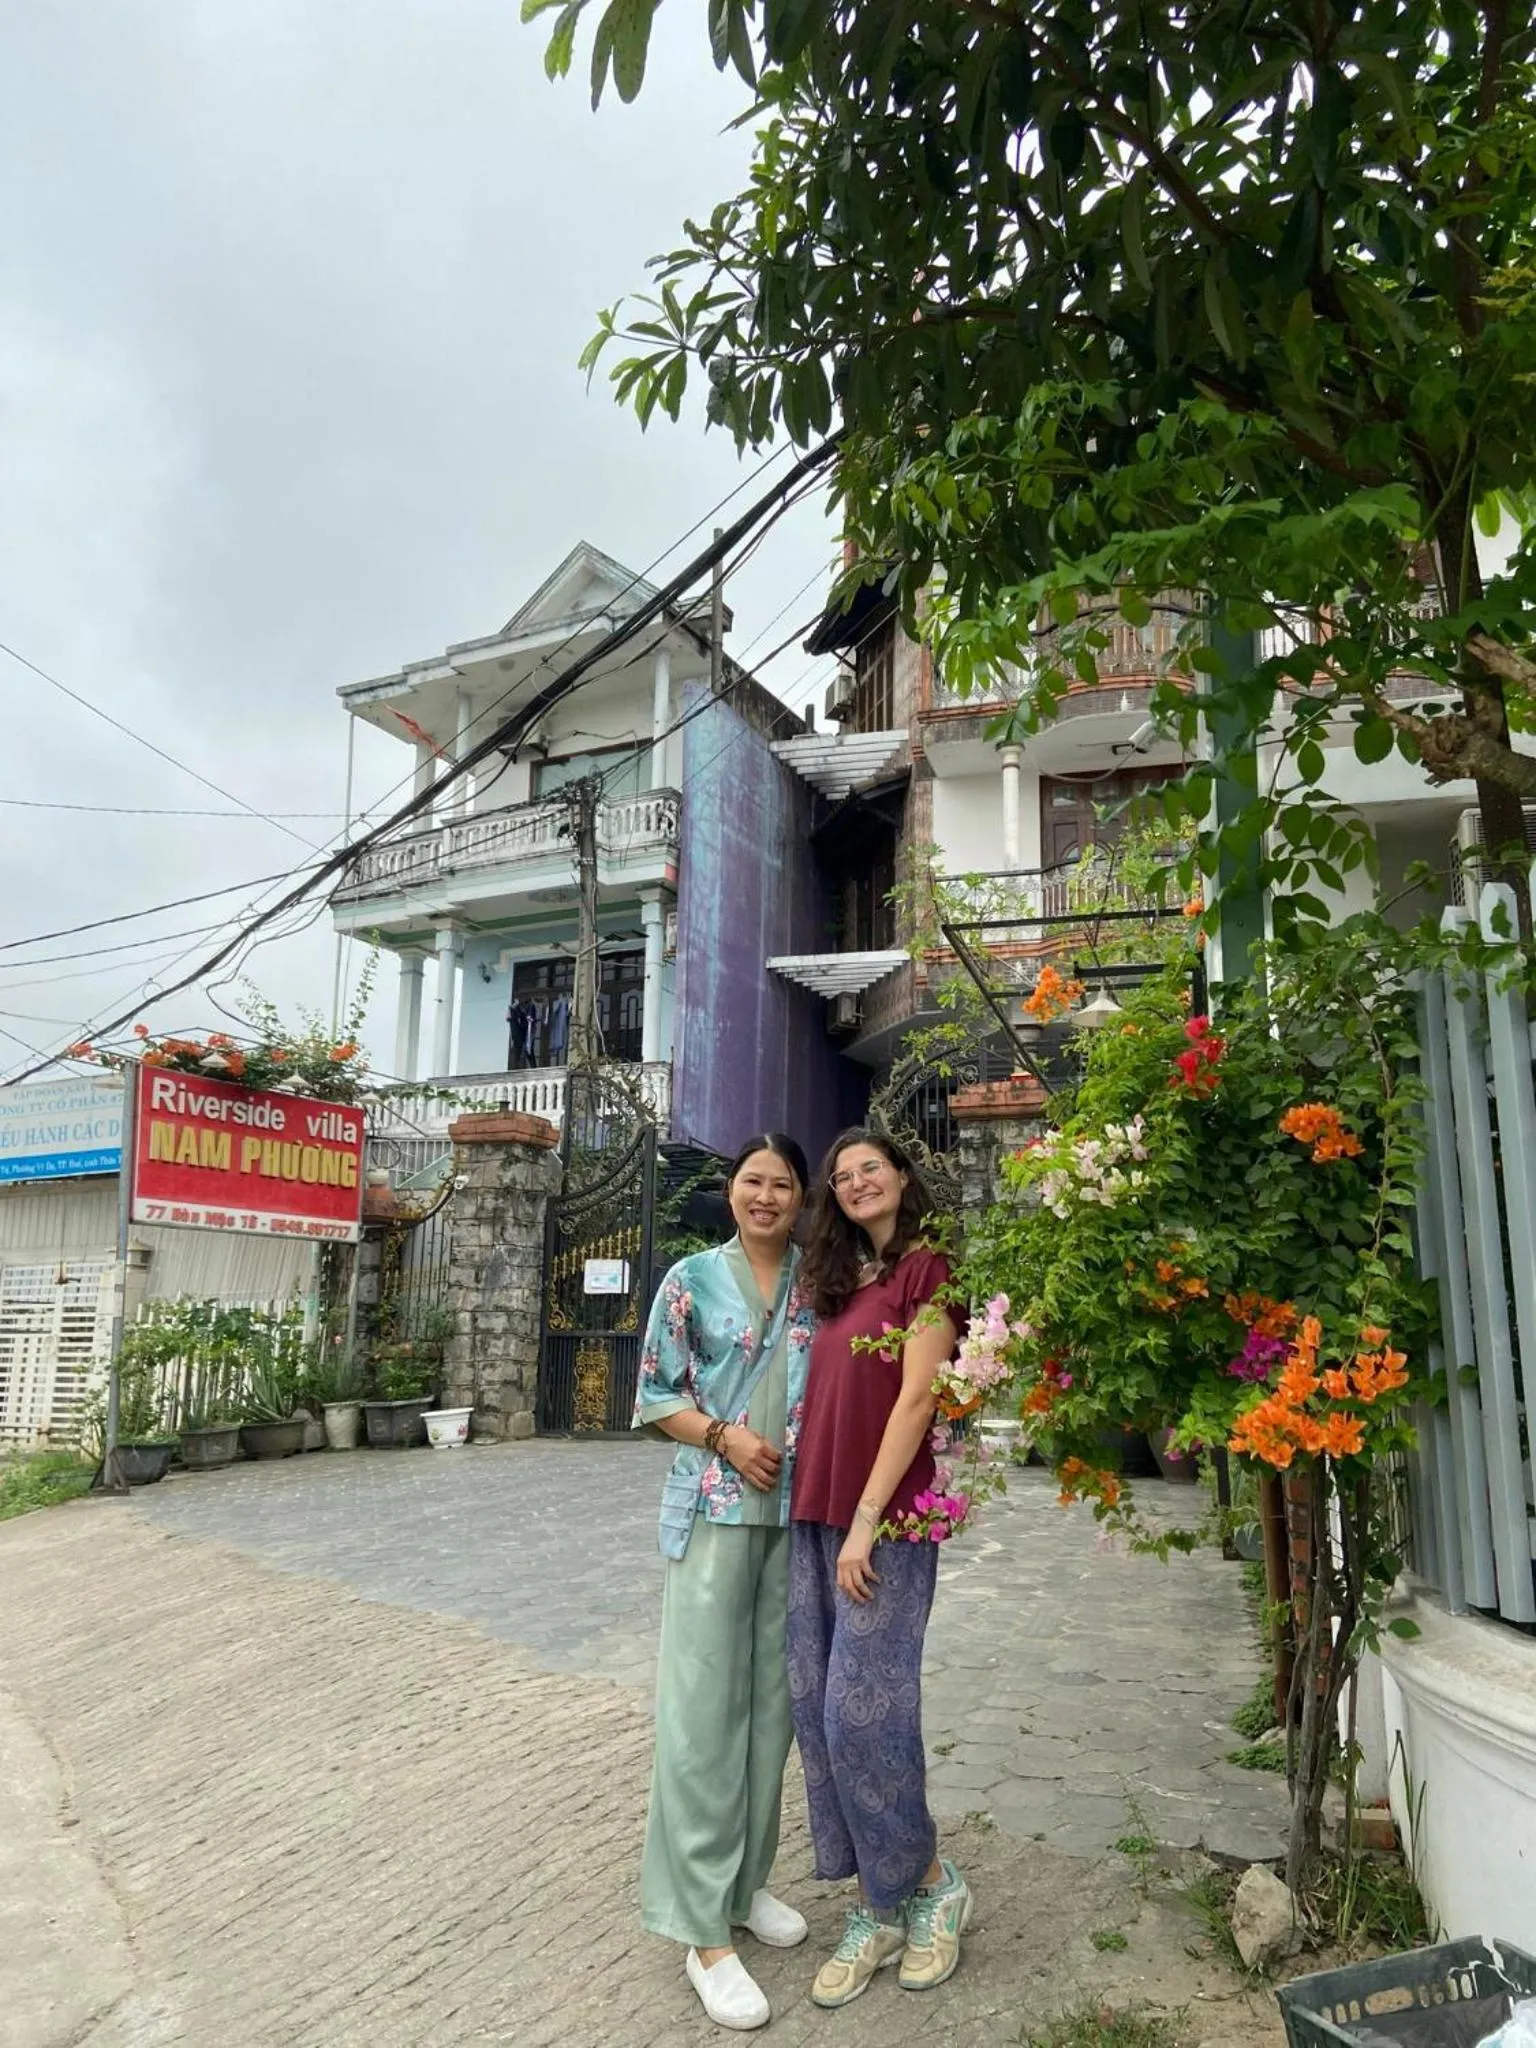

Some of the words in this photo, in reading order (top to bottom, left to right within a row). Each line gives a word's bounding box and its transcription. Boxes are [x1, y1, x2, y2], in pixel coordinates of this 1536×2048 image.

[0, 1103, 24, 1116] ÔNG
[151, 1076, 285, 1130] Riverside
[306, 1112, 357, 1144] villa
[149, 1120, 232, 1171] NAM
[240, 1136, 357, 1188] PHƯƠNG
[146, 1204, 168, 1219] 77
